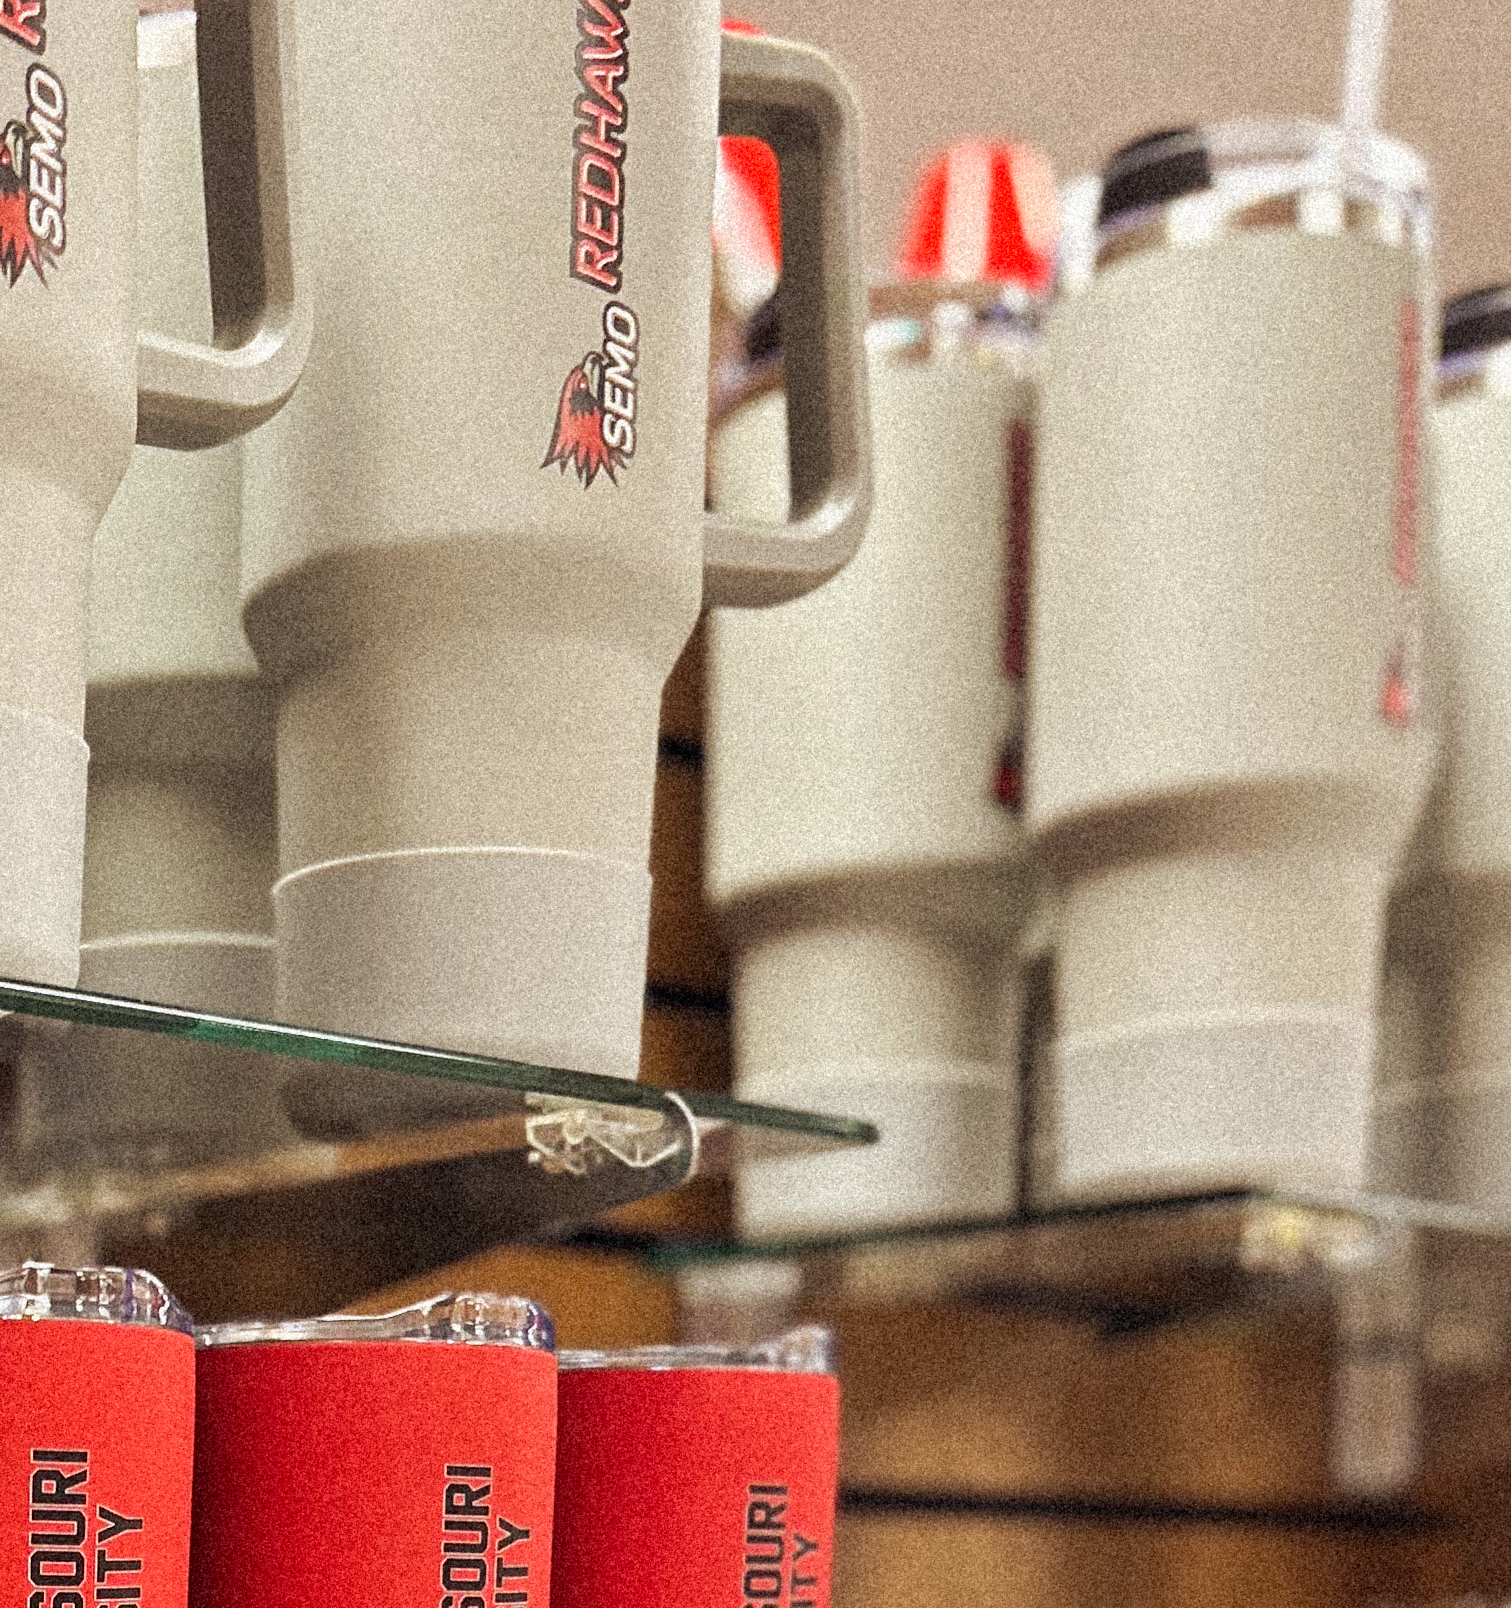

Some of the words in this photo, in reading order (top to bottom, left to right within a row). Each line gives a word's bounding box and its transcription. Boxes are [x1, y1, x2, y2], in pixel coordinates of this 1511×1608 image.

[26, 62, 67, 256] SEMO
[569, 0, 631, 294] REDHAW
[602, 300, 639, 460] SEMO
